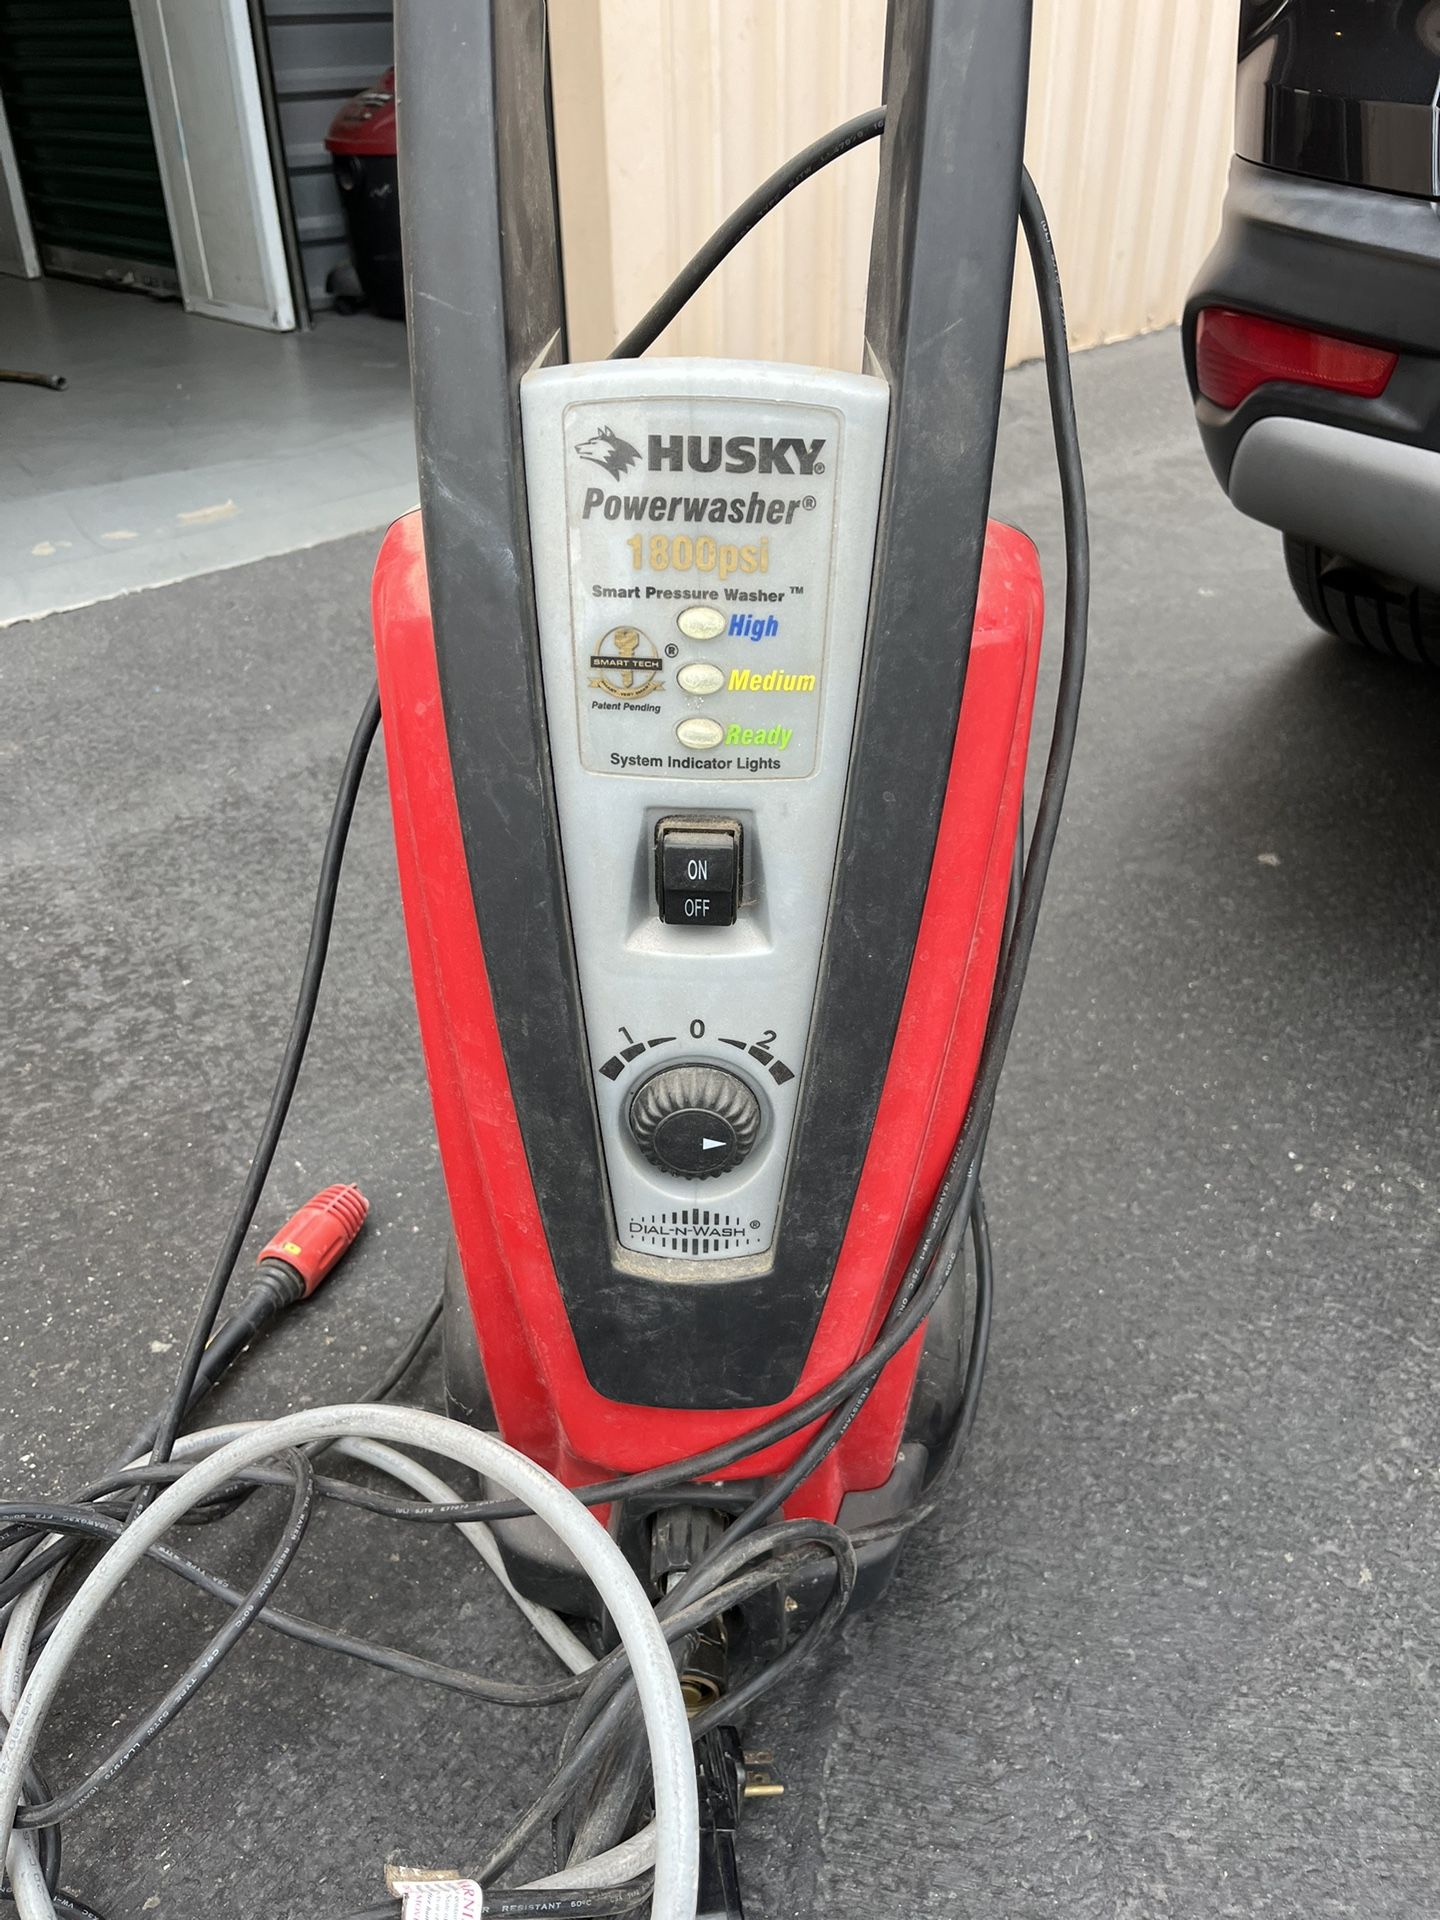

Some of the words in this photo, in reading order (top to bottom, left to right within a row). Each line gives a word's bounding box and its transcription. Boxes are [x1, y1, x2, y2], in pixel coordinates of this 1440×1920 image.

[626, 533, 770, 580] 1800psi
[592, 585, 640, 600] Smart
[646, 587, 720, 601] Pressure
[724, 588, 785, 602] Washer
[728, 614, 779, 641] High
[593, 658, 629, 667] SMART
[632, 660, 660, 668] TECH
[728, 669, 816, 691] Medium
[592, 701, 621, 712] Patent
[623, 702, 661, 714] Pending
[724, 724, 793, 750] Ready
[610, 753, 662, 768] System
[668, 756, 732, 770] Indicator
[737, 757, 781, 772] Lights
[687, 859, 708, 881] ON
[684, 899, 710, 917] OFF
[618, 1026, 634, 1044] 1
[689, 1019, 705, 1039] 0
[755, 1029, 777, 1050] 2
[186, 1560, 206, 1575] TYPE
[258, 1547, 290, 1598] RESISTANT
[201, 1648, 219, 1668] CSA
[175, 1678, 197, 1703] TYPE
[53, 1895, 74, 1909] VW-1
[502, 1901, 562, 1913] RESISTANT
